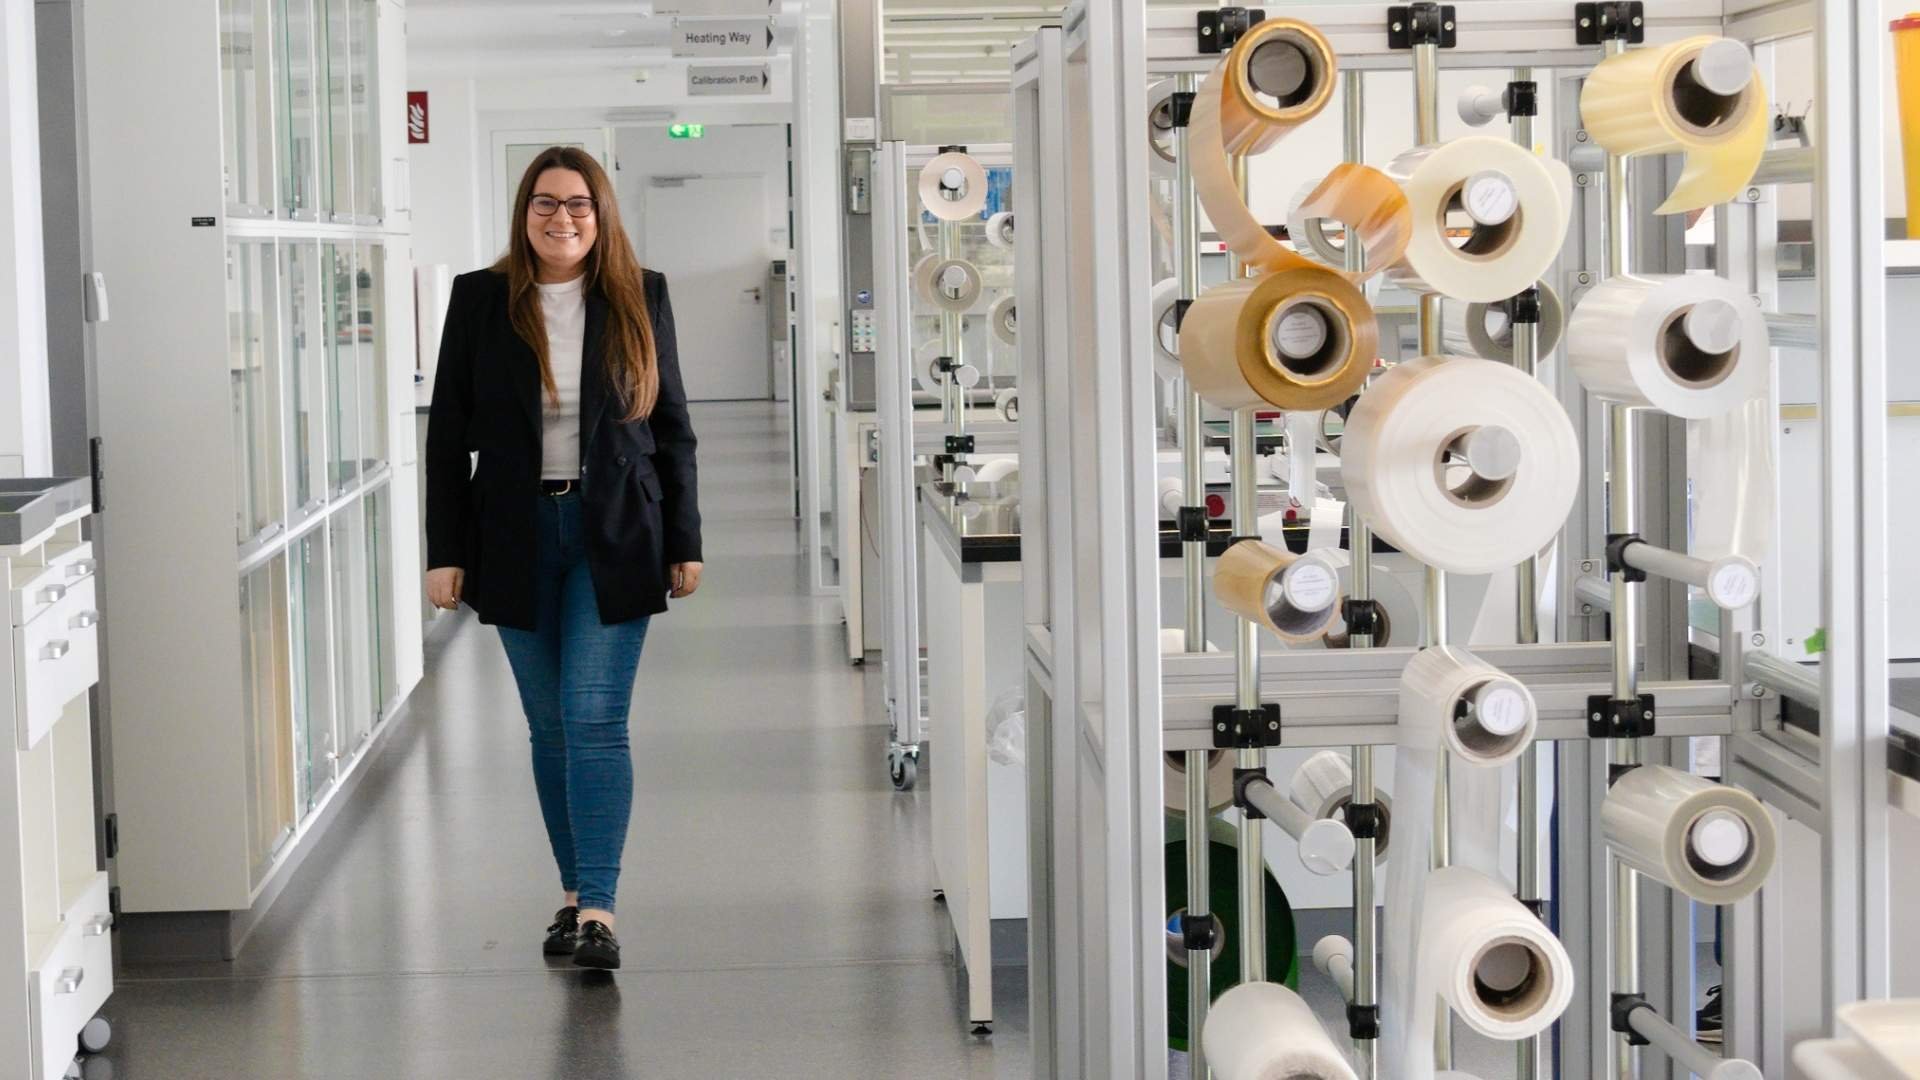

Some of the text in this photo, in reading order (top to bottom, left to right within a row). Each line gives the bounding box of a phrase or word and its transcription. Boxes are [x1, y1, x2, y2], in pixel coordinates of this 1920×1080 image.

[686, 32, 751, 45] Heating Way
[691, 74, 758, 85] Calibration Path
